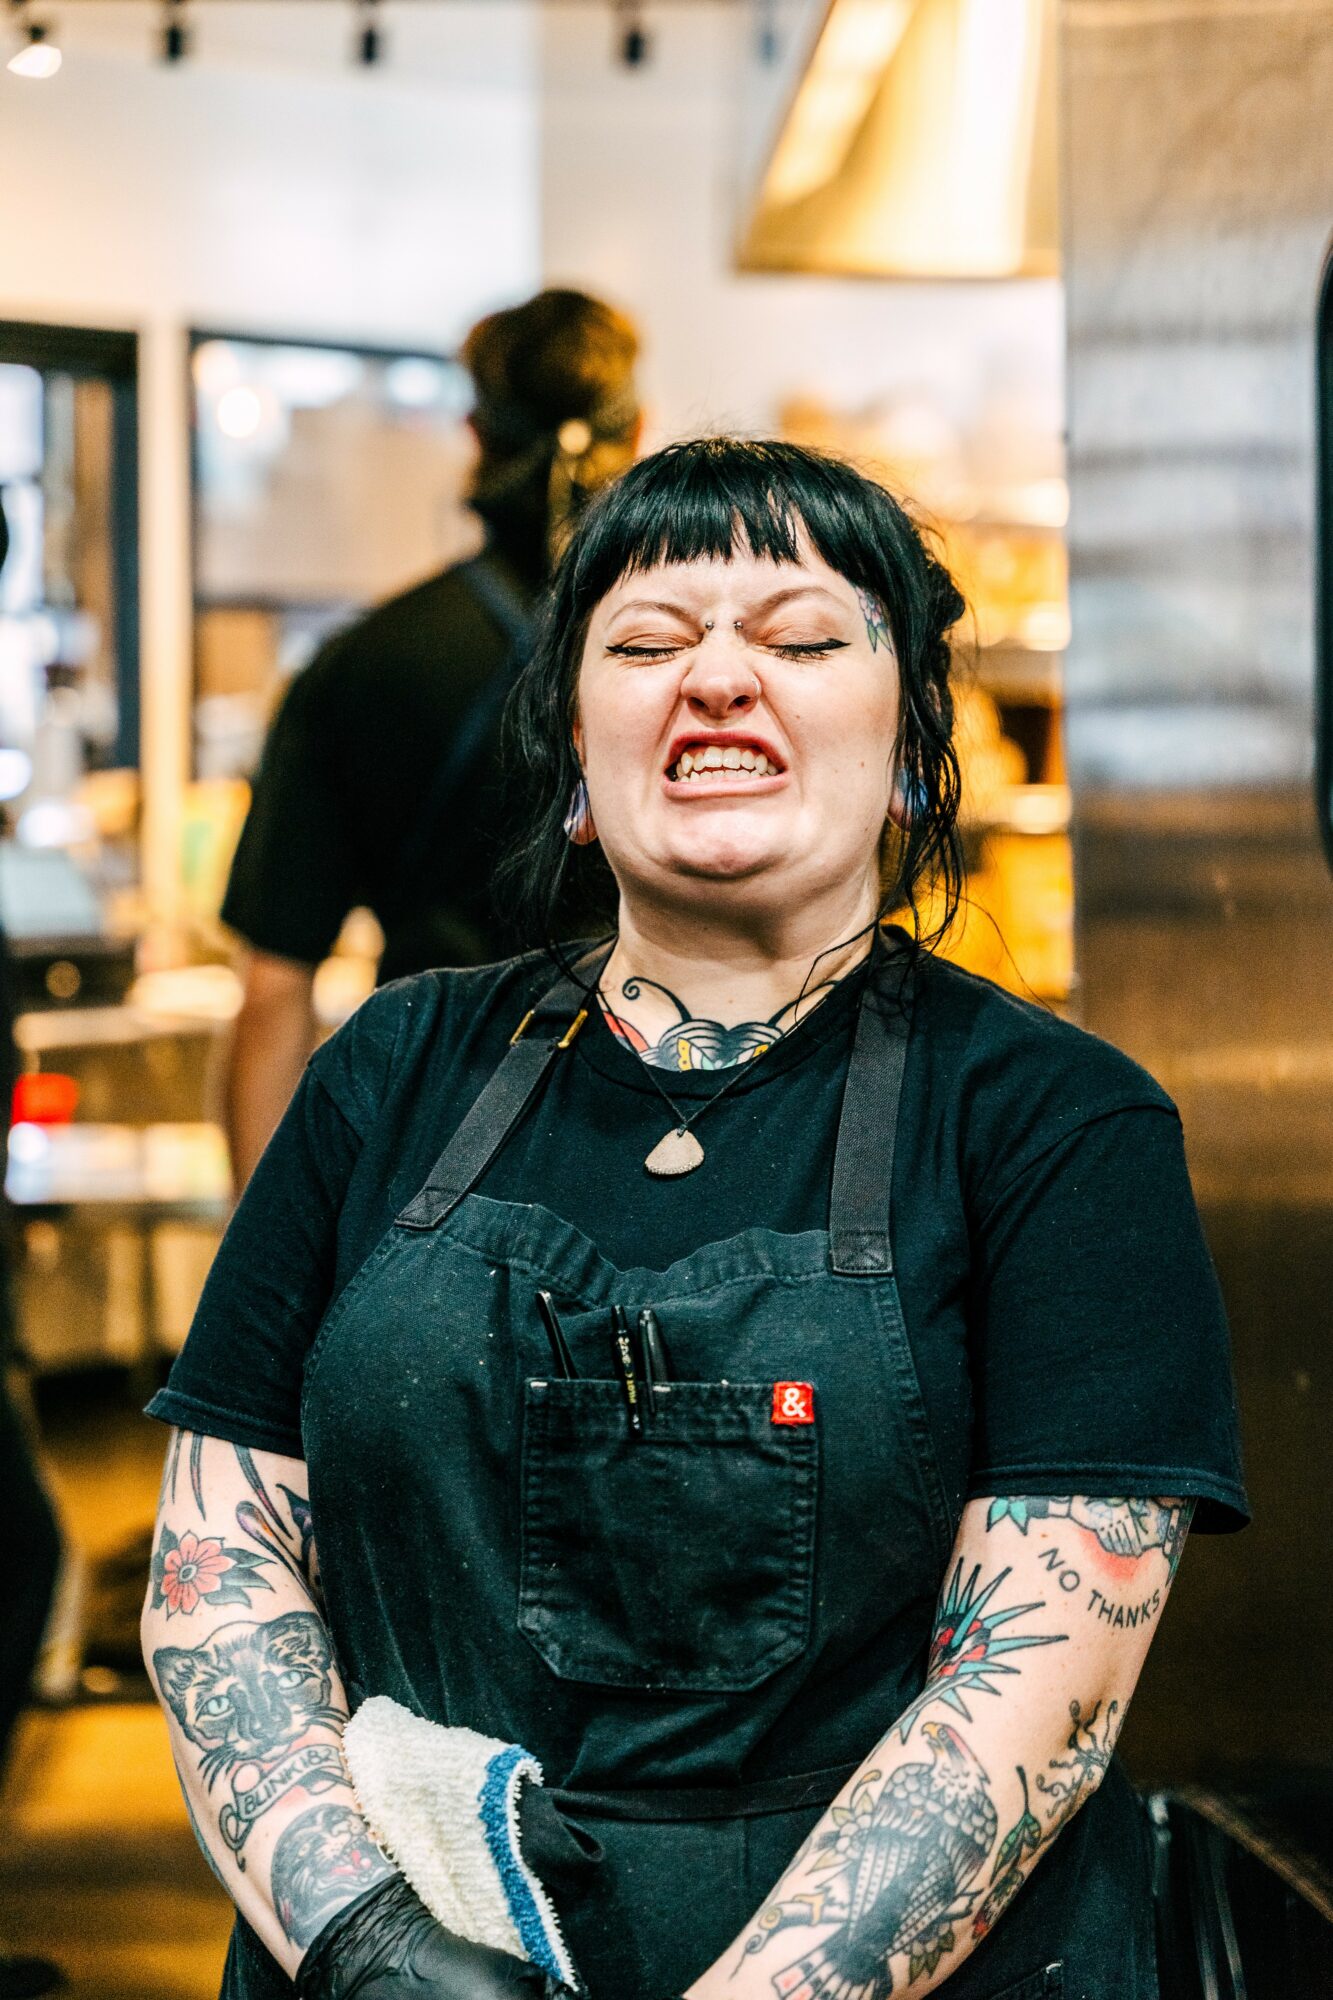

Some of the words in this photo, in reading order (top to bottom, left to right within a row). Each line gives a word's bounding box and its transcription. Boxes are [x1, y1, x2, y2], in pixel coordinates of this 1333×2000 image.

[782, 1387, 807, 1418] &
[1038, 1547, 1080, 1592] NO
[1087, 1589, 1160, 1629] THANKS
